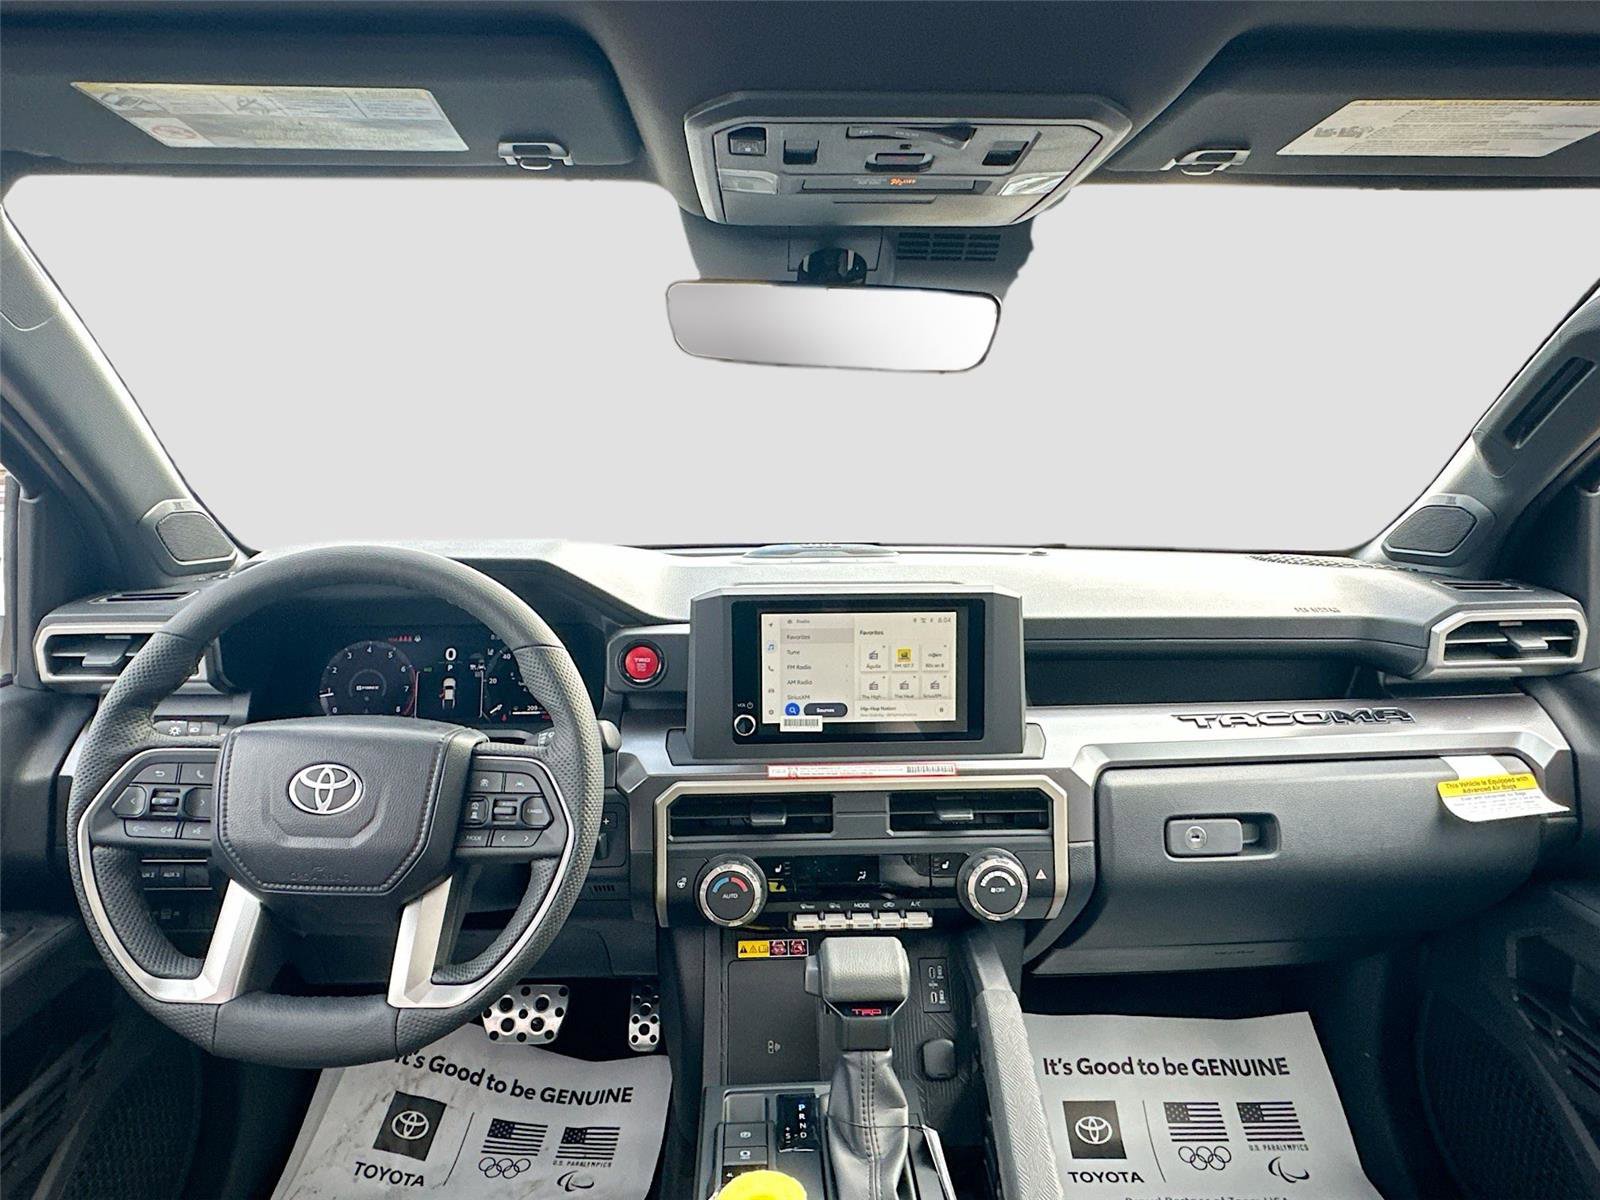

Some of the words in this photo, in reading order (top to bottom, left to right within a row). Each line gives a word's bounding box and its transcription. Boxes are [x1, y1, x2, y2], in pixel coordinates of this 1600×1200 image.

[388, 651, 393, 659] 5
[445, 647, 457, 661] 0
[1171, 707, 1416, 729] TACOMA
[1487, 778, 1515, 786] Equipped
[852, 1008, 881, 1016] TRD
[1043, 1057, 1073, 1075] It's
[1076, 1056, 1134, 1075] Good
[1137, 1058, 1160, 1075] to
[1162, 1057, 1188, 1076] be
[1191, 1057, 1290, 1077] GENUINE
[428, 1055, 486, 1087] Good
[486, 1073, 507, 1093] to
[510, 1079, 536, 1099] be
[540, 1086, 634, 1106] GENUINE
[798, 1103, 805, 1111] P
[1262, 1143, 1309, 1151] PARALYMPICS
[354, 1161, 425, 1187] TOYOTA
[1067, 1171, 1145, 1184] TOYOTA
